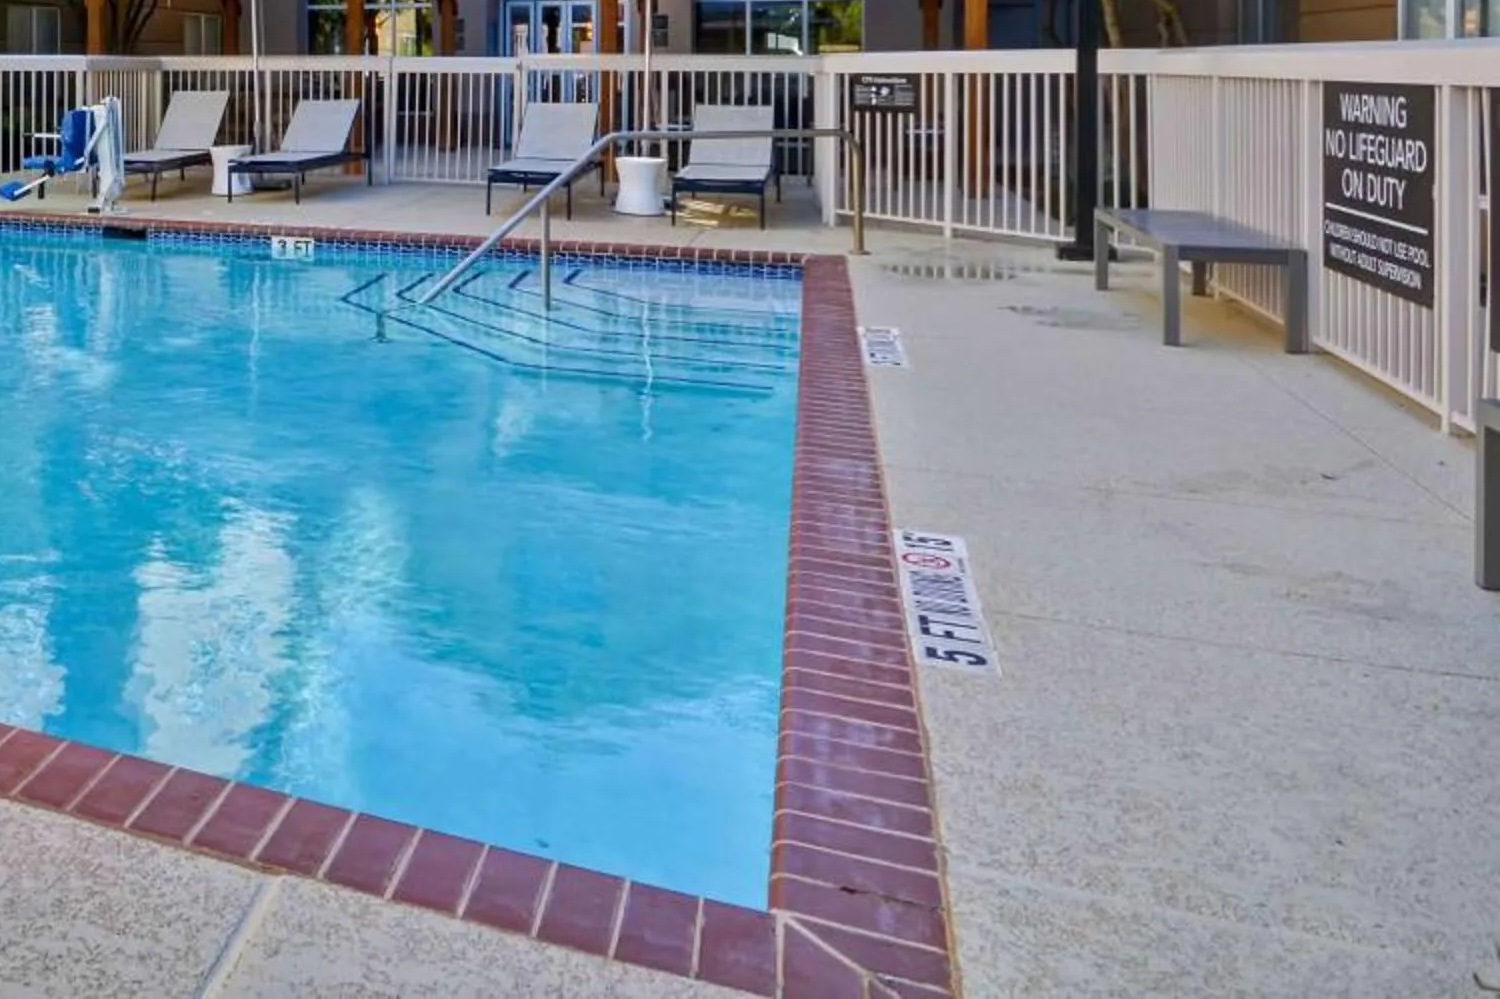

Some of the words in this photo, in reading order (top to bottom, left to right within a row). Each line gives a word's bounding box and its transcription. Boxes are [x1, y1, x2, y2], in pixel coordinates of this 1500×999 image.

[1340, 93, 1407, 128] WARNING
[1325, 128, 1347, 158] NO
[1349, 133, 1427, 173] LIFEGUARD
[1341, 168, 1364, 199] ON
[1367, 173, 1406, 210] DUTY
[294, 240, 312, 257] FT
[1409, 246, 1430, 268] POOL
[918, 614, 981, 643] FT
[925, 646, 988, 665] 5
